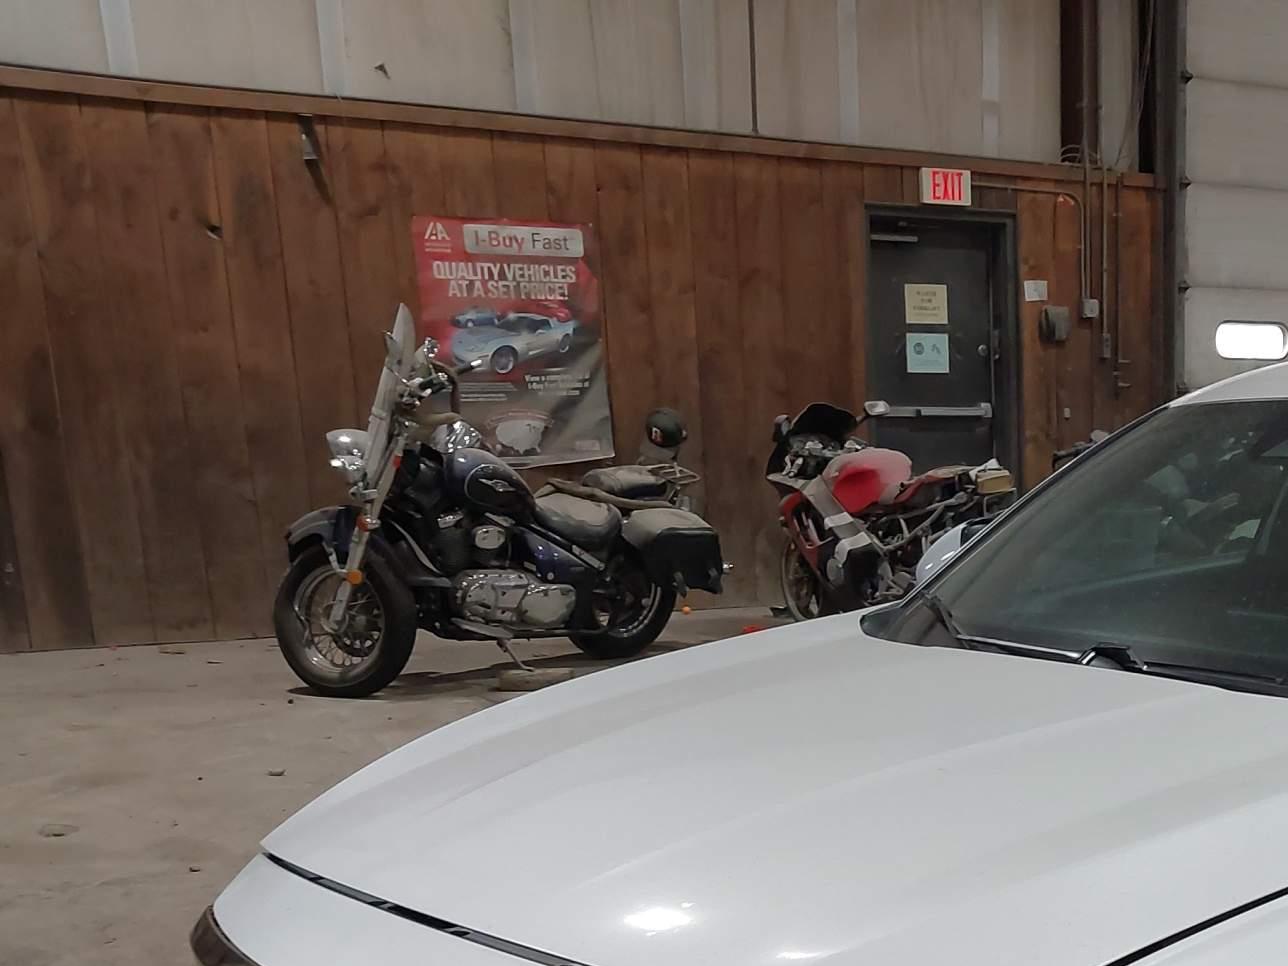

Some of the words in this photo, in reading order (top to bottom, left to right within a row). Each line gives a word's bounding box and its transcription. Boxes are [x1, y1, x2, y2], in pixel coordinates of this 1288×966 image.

[932, 170, 963, 201] EXIT
[474, 230, 525, 253] I-Buy
[531, 232, 569, 251] Fast
[433, 261, 501, 281] QUALITY
[503, 263, 576, 283] VEHICLES
[449, 280, 470, 297] AT
[473, 281, 485, 298] A
[487, 282, 517, 299] SET
[520, 283, 569, 300] PRICE!
